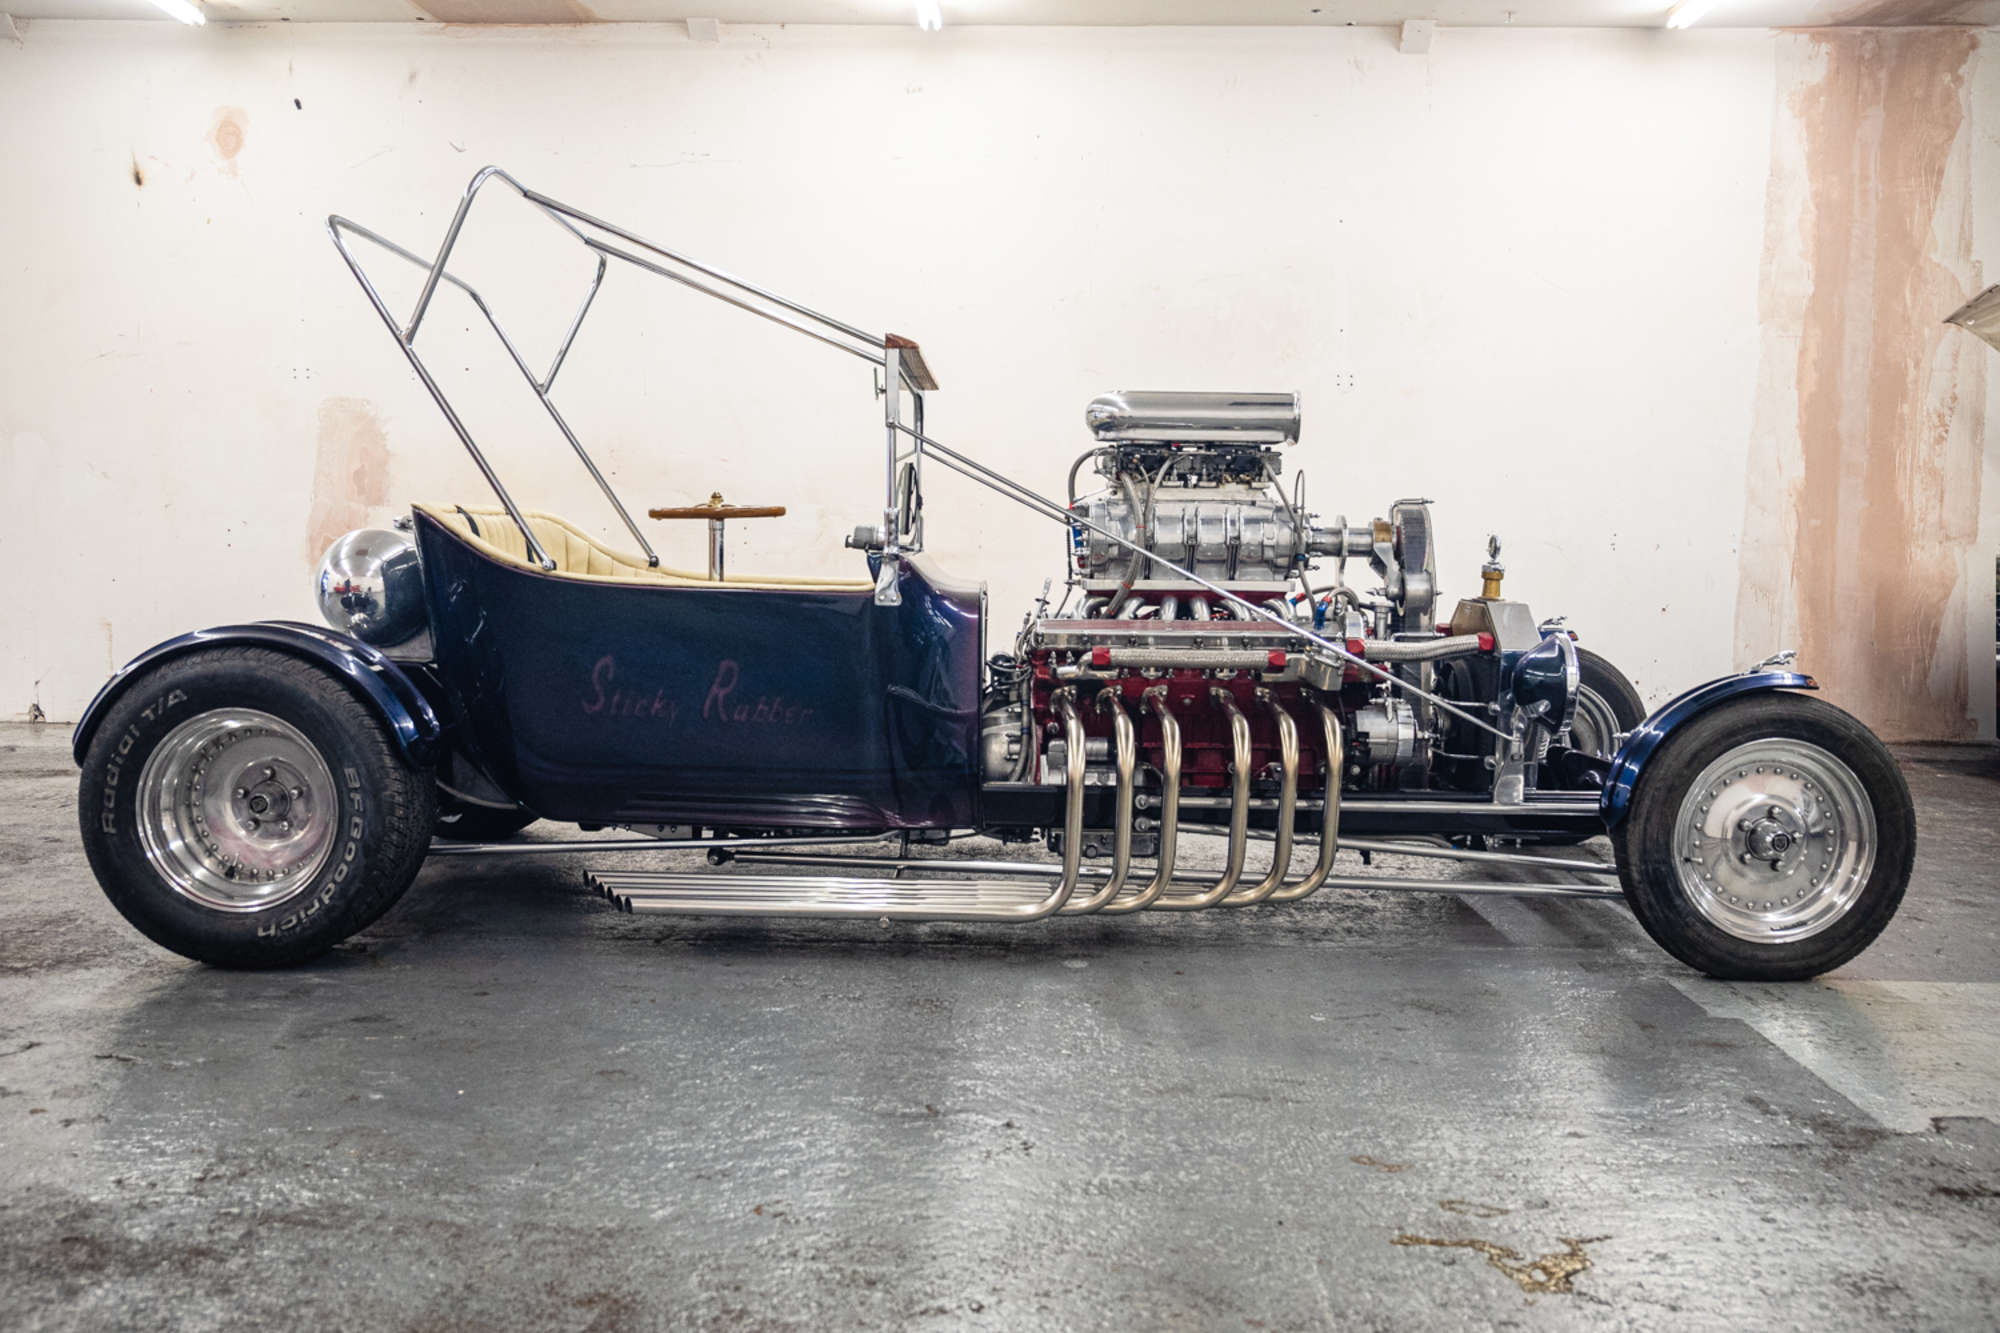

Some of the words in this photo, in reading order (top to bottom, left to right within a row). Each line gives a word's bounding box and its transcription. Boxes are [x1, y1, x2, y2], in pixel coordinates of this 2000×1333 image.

[102, 723, 142, 834] Radial
[141, 689, 188, 721] T/A
[582, 655, 679, 727] Sticky
[703, 659, 815, 722] Rubber
[257, 767, 364, 937] BFGoodrich
